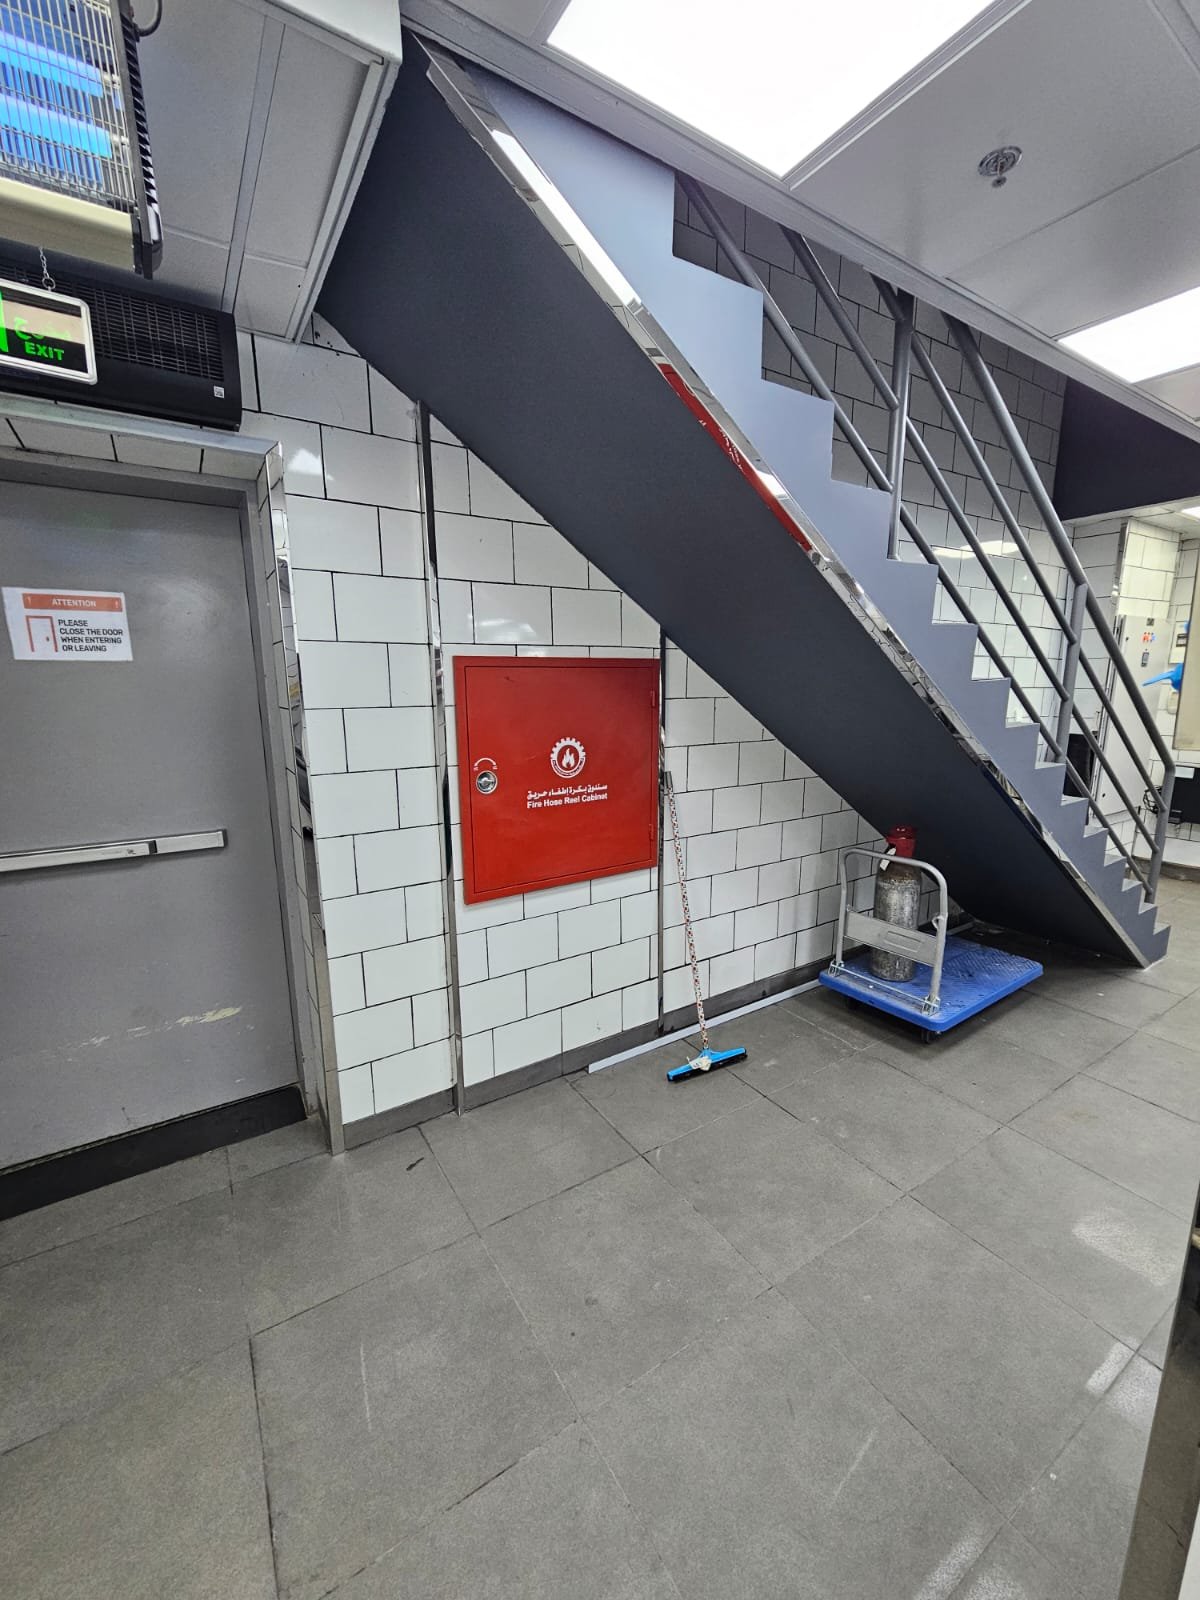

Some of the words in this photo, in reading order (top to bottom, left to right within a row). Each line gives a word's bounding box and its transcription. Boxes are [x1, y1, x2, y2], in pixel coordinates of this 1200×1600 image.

[25, 341, 65, 361] EXIT
[52, 598, 97, 608] ATTENTION
[58, 619, 88, 627] PLEASE
[86, 628, 102, 636] THE
[103, 628, 123, 636] DOOR
[61, 636, 84, 644] WHEN
[85, 636, 123, 644] ENTERING
[527, 800, 543, 809] Fire
[543, 798, 563, 807] Hose
[564, 796, 581, 805] Reel
[582, 793, 608, 802] Cabinet
